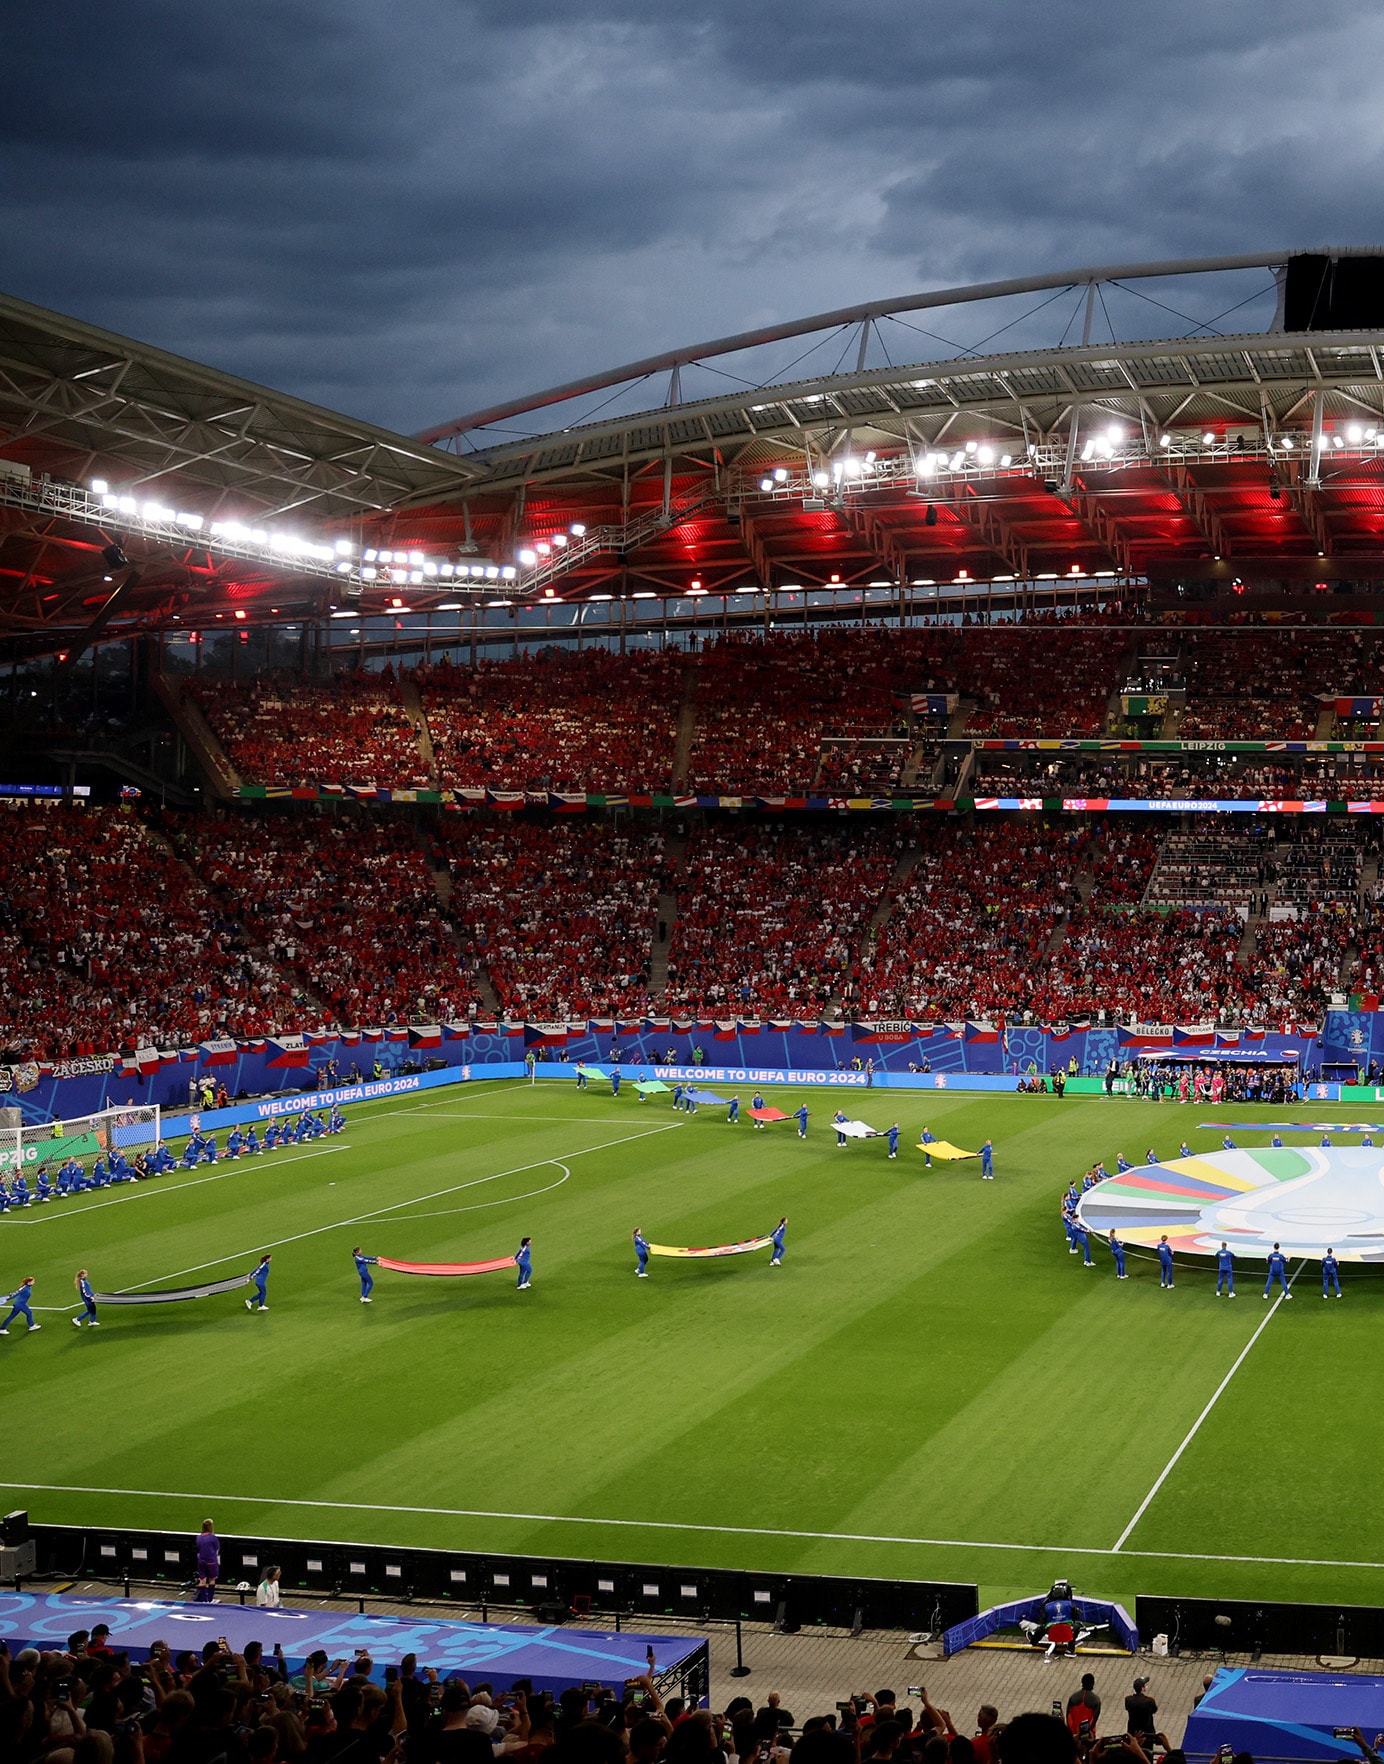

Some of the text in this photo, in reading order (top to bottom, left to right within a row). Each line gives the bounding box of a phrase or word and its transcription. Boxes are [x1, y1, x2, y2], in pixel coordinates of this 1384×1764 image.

[1181, 742, 1226, 750] LEIPZIG
[654, 1067, 866, 1084] WELCOME TO UEFA EURO 2024
[258, 1077, 419, 1116] WELCOME TO UEFA EURO 2024
